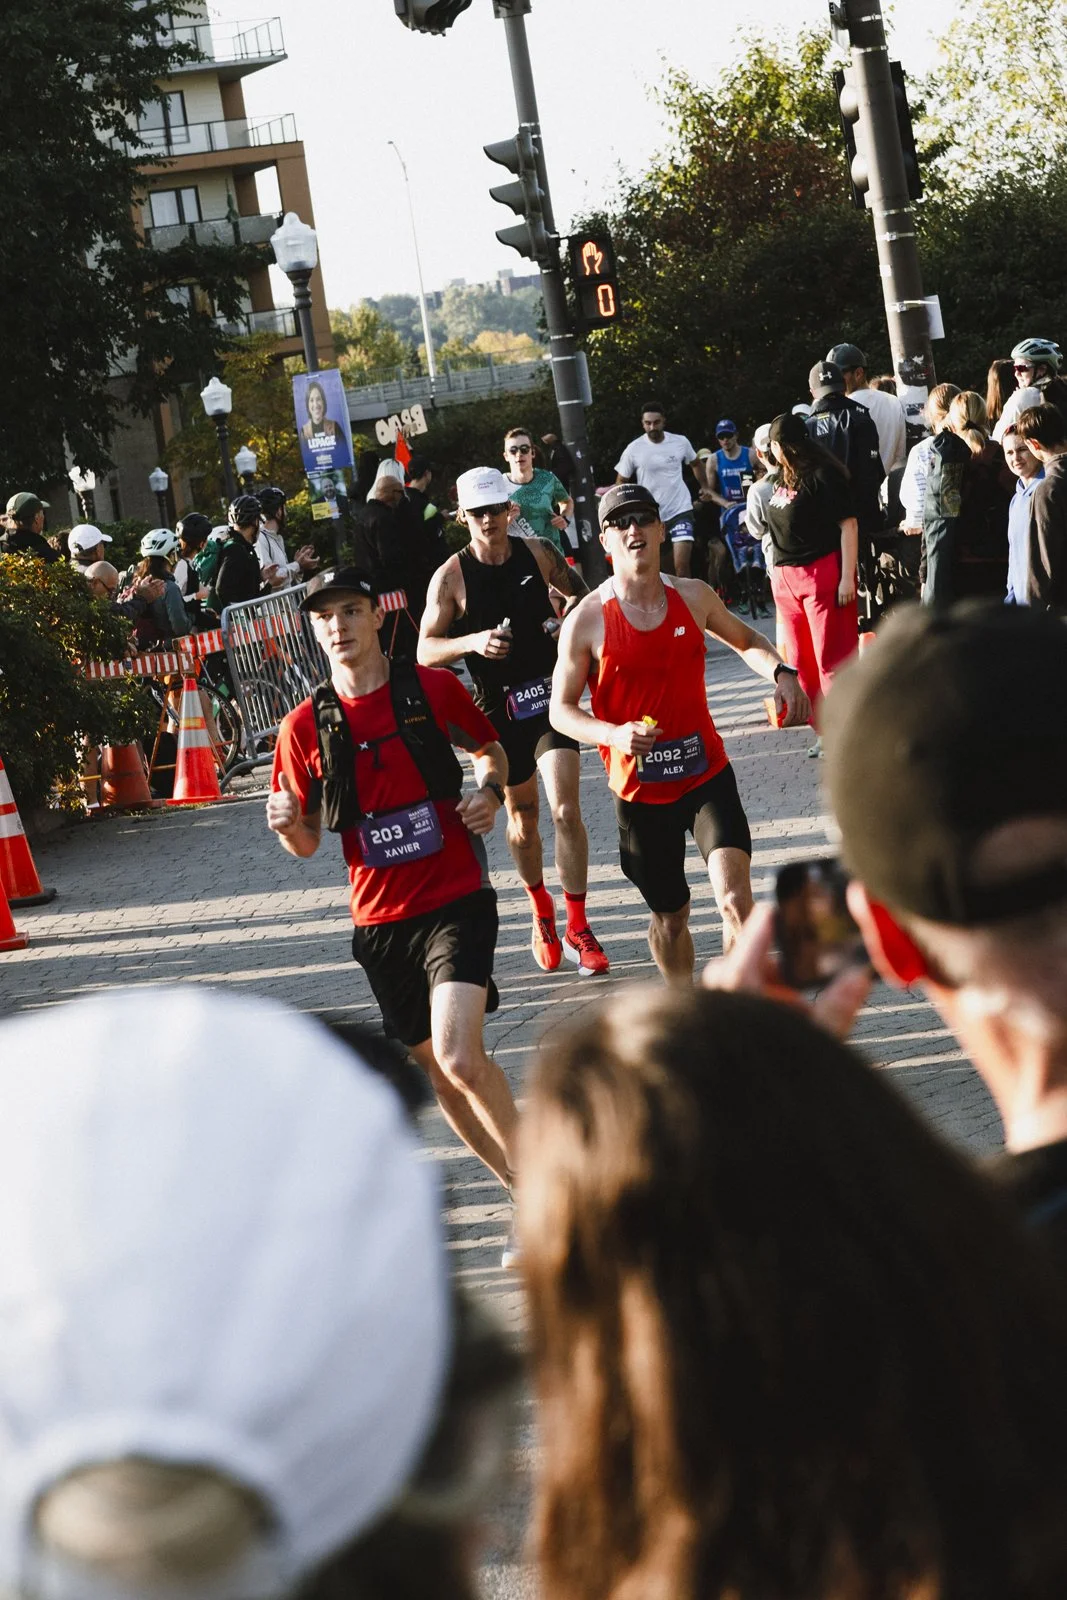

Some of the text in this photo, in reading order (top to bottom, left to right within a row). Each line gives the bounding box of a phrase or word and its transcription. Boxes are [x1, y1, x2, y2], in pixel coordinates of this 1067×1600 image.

[598, 284, 615, 317] 0
[308, 435, 337, 450] LEPAGE
[515, 684, 545, 703] 2405
[645, 748, 682, 763] 2092
[663, 765, 684, 775] ALEX
[370, 824, 404, 844] 203
[384, 841, 421, 858] XAVIER
